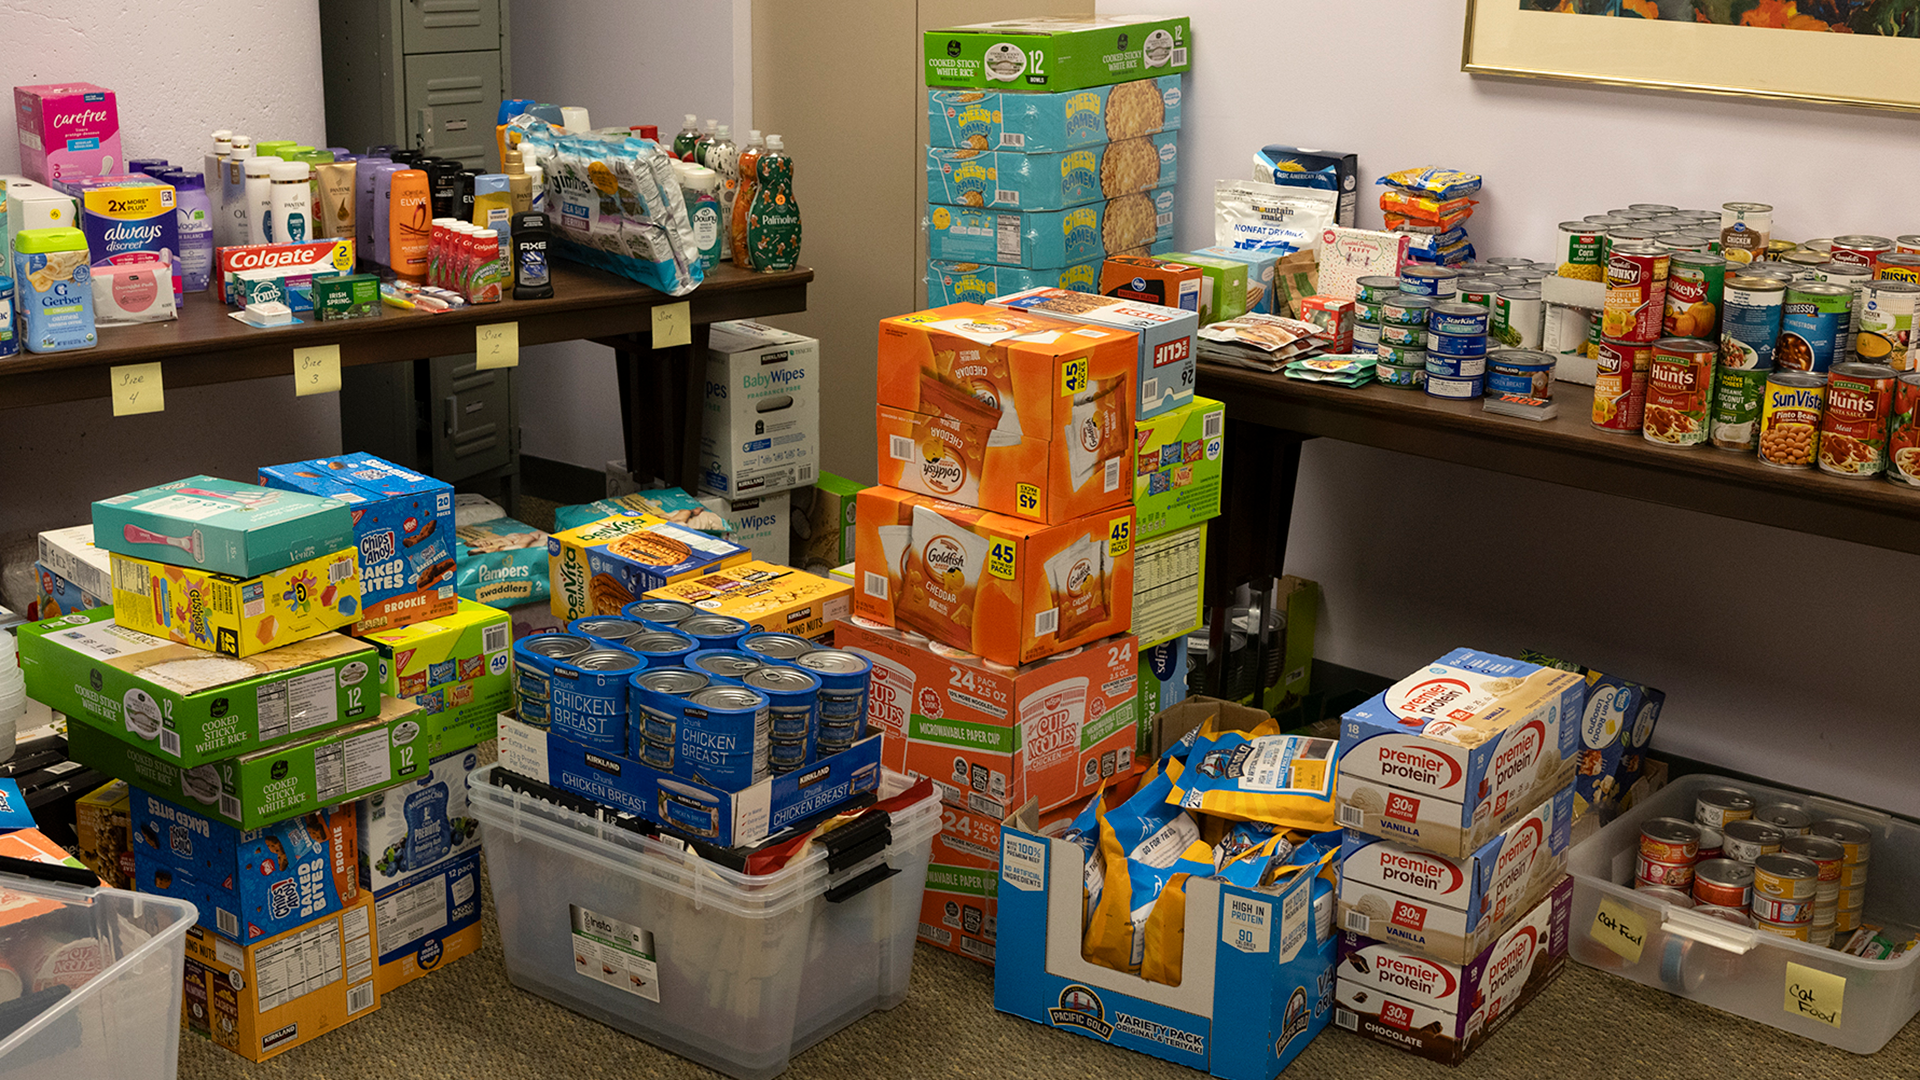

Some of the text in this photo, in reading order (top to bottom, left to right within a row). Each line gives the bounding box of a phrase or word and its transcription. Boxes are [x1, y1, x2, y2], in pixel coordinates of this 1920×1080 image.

[929, 59, 981, 69] COOKED STICKY
[1029, 50, 1044, 74] 12
[936, 67, 975, 77] WHITE RICE
[1065, 93, 1100, 112] CHEESY
[54, 109, 107, 128] carefree
[958, 110, 991, 127] CHEESY
[1065, 112, 1100, 136] RAMEN
[961, 122, 992, 139] RAMEN
[1061, 151, 1096, 171] CHEESY
[551, 172, 591, 194] gimme
[954, 167, 986, 183] CHEESY
[1061, 170, 1096, 194] RAMEN
[956, 179, 987, 194] RAMEN
[108, 200, 126, 212] 2x
[400, 197, 426, 207] ELVIVE
[1252, 204, 1294, 215] mountain
[693, 213, 718, 224] Downy
[762, 214, 799, 226] Palmolive
[1063, 208, 1097, 230] CHEESY
[1261, 214, 1283, 222] maid
[104, 222, 163, 244] always
[1064, 229, 1097, 253] RAMEN
[106, 240, 143, 251] discreet
[474, 242, 499, 250] Colgate
[520, 242, 547, 250] AXE
[1578, 249, 1594, 258] Corn
[230, 248, 317, 268] Colgate
[42, 295, 82, 307] Gerber
[250, 286, 281, 304] Tom's
[657, 311, 677, 323] Size
[1446, 316, 1475, 325] StarKist
[482, 328, 503, 342] Size
[491, 342, 501, 354] 2
[302, 357, 322, 369] Size
[955, 365, 988, 379] CHEDDAR
[120, 373, 145, 386] Size
[310, 373, 319, 384] 3
[743, 368, 805, 389] BabyWipes
[1065, 362, 1079, 391] 45
[1652, 364, 1694, 385] Hunt's
[1722, 374, 1743, 382] NATIVE
[129, 391, 140, 404] 4
[1500, 395, 1544, 407] TACO
[1657, 396, 1673, 405] Meat
[1718, 393, 1745, 404] COCONUT
[1722, 402, 1737, 411] MILK
[1772, 390, 1822, 410] SunVista
[1829, 390, 1874, 413] Hunt's
[1776, 412, 1817, 421] Pinto Beans
[930, 426, 964, 449] CHEDDAR
[1086, 417, 1097, 448] Goldfish
[1834, 423, 1852, 433] Meat
[1206, 441, 1220, 452] 40
[923, 463, 961, 483] Goldfish
[438, 496, 449, 507] 20
[1019, 494, 1038, 509] 45
[576, 515, 648, 543] belVita
[1111, 521, 1129, 541] 45
[289, 545, 316, 562] Venus
[361, 533, 390, 556] Chips
[991, 542, 1014, 564] 45
[1110, 543, 1128, 554] PACKS
[928, 548, 964, 568] Goldfish
[478, 565, 528, 583] Pampers
[990, 564, 1013, 576] PACKS
[480, 583, 528, 599] swaddlers
[565, 547, 577, 622] belVita
[577, 562, 585, 614] CRUNCHY
[926, 580, 957, 604] CHEDDAR
[384, 596, 427, 614] BROOKIE
[1107, 642, 1132, 668] 24
[553, 677, 575, 690] Chunk
[949, 666, 976, 692] 24
[977, 676, 998, 689] PACK
[346, 687, 363, 709] 12
[554, 692, 616, 716] CHICKEN
[1399, 683, 1445, 714] premier
[201, 715, 239, 733] COOKED
[555, 709, 607, 735] BREAST
[683, 716, 702, 727] Chunk
[1587, 698, 1603, 736] Lasagna
[204, 725, 237, 742] STICKY
[919, 722, 1000, 746] MICROWAVABLE PAPER CUP
[1348, 723, 1360, 735] 18
[195, 731, 248, 754] WHITE RICE
[682, 728, 736, 750] CHICKEN
[1027, 722, 1077, 761] NOODLES
[399, 747, 414, 766] 12
[586, 753, 621, 772] KIRKLAND
[682, 746, 729, 766] BREAST
[1032, 750, 1062, 769] CHICKEN
[1378, 746, 1444, 773] premier
[1495, 731, 1536, 776] premier
[592, 772, 614, 786] Chunk
[799, 768, 830, 788] KIRKLAND
[1381, 761, 1438, 786] protein
[1496, 753, 1532, 791] protein
[262, 776, 298, 794] COOKED
[562, 772, 647, 813] CHICKEN BREAST
[803, 787, 822, 799] Chunk
[257, 793, 307, 815] WHITE RICE
[265, 789, 296, 803] STICKY
[773, 784, 849, 827] CHICKEN BREAST
[1391, 796, 1415, 813] 30g
[943, 811, 971, 836] 24
[973, 821, 996, 835] PACK
[1379, 819, 1421, 838] VANILLA
[333, 825, 344, 874] BROOKIE
[1018, 842, 1041, 858] 100%
[1498, 829, 1535, 877] premier
[1379, 851, 1445, 878] premier
[300, 862, 313, 918] BAKED
[312, 857, 324, 912] BITES
[1003, 871, 1042, 888] INGREDIENTS
[1383, 866, 1438, 890] protein
[1232, 900, 1265, 916] HIGH IN
[590, 916, 612, 933] Insta
[1231, 910, 1264, 926] PROTEIN
[1238, 928, 1253, 943] 90
[1385, 925, 1426, 945] VANILLA
[1618, 922, 1643, 947] Food
[1488, 936, 1529, 982] premier
[1376, 954, 1439, 985] premier
[1489, 960, 1526, 998] protein
[1378, 969, 1432, 995] protein
[1789, 983, 1816, 1001] Cat
[1386, 1004, 1408, 1020] 30g
[1798, 1000, 1837, 1024] Food
[1053, 1012, 1110, 1036] PACIFIC GOLD
[1115, 1011, 1204, 1047] VARIETY PACK
[263, 1024, 296, 1047] KIRKLAND
[1364, 1021, 1423, 1049] CHOCOLATE
